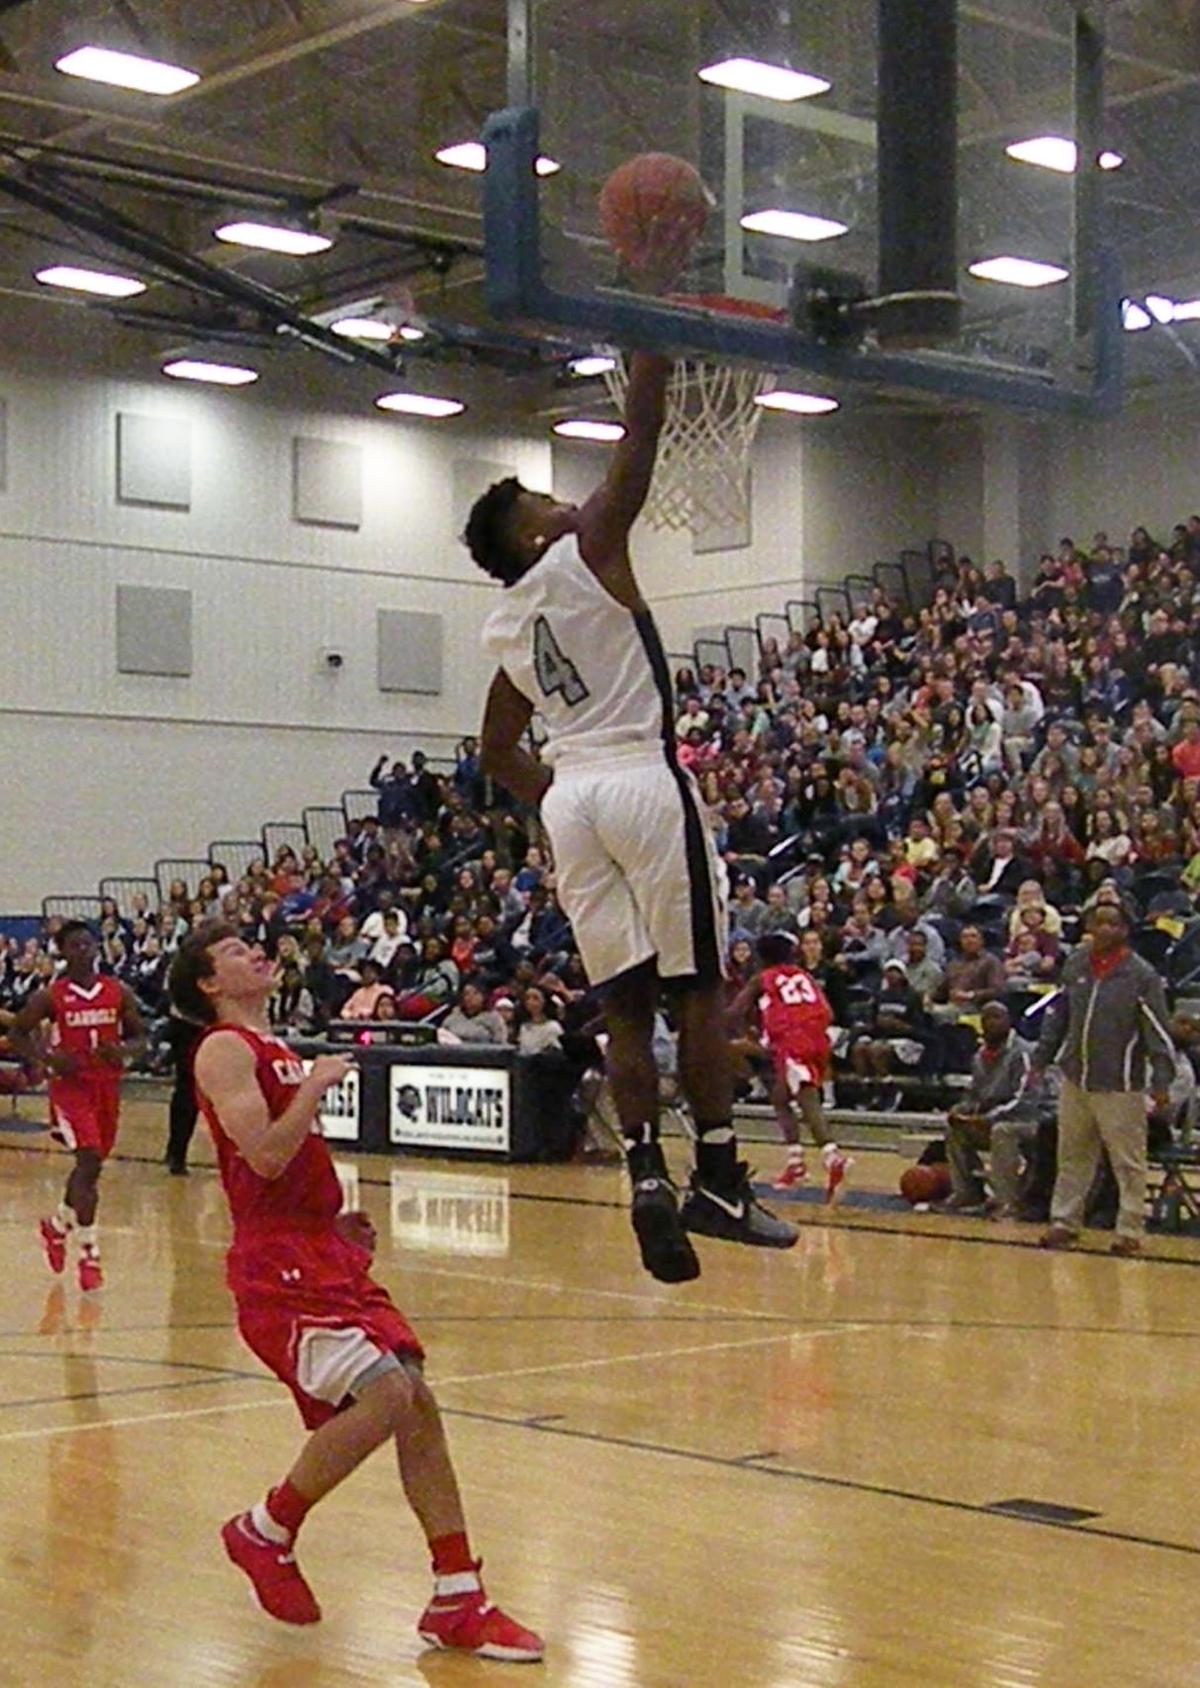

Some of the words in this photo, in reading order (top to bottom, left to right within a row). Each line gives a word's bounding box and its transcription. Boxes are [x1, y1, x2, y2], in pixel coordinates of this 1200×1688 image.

[533, 614, 590, 706] 4
[775, 974, 817, 1004] 23
[425, 1085, 503, 1128] WILDCATS
